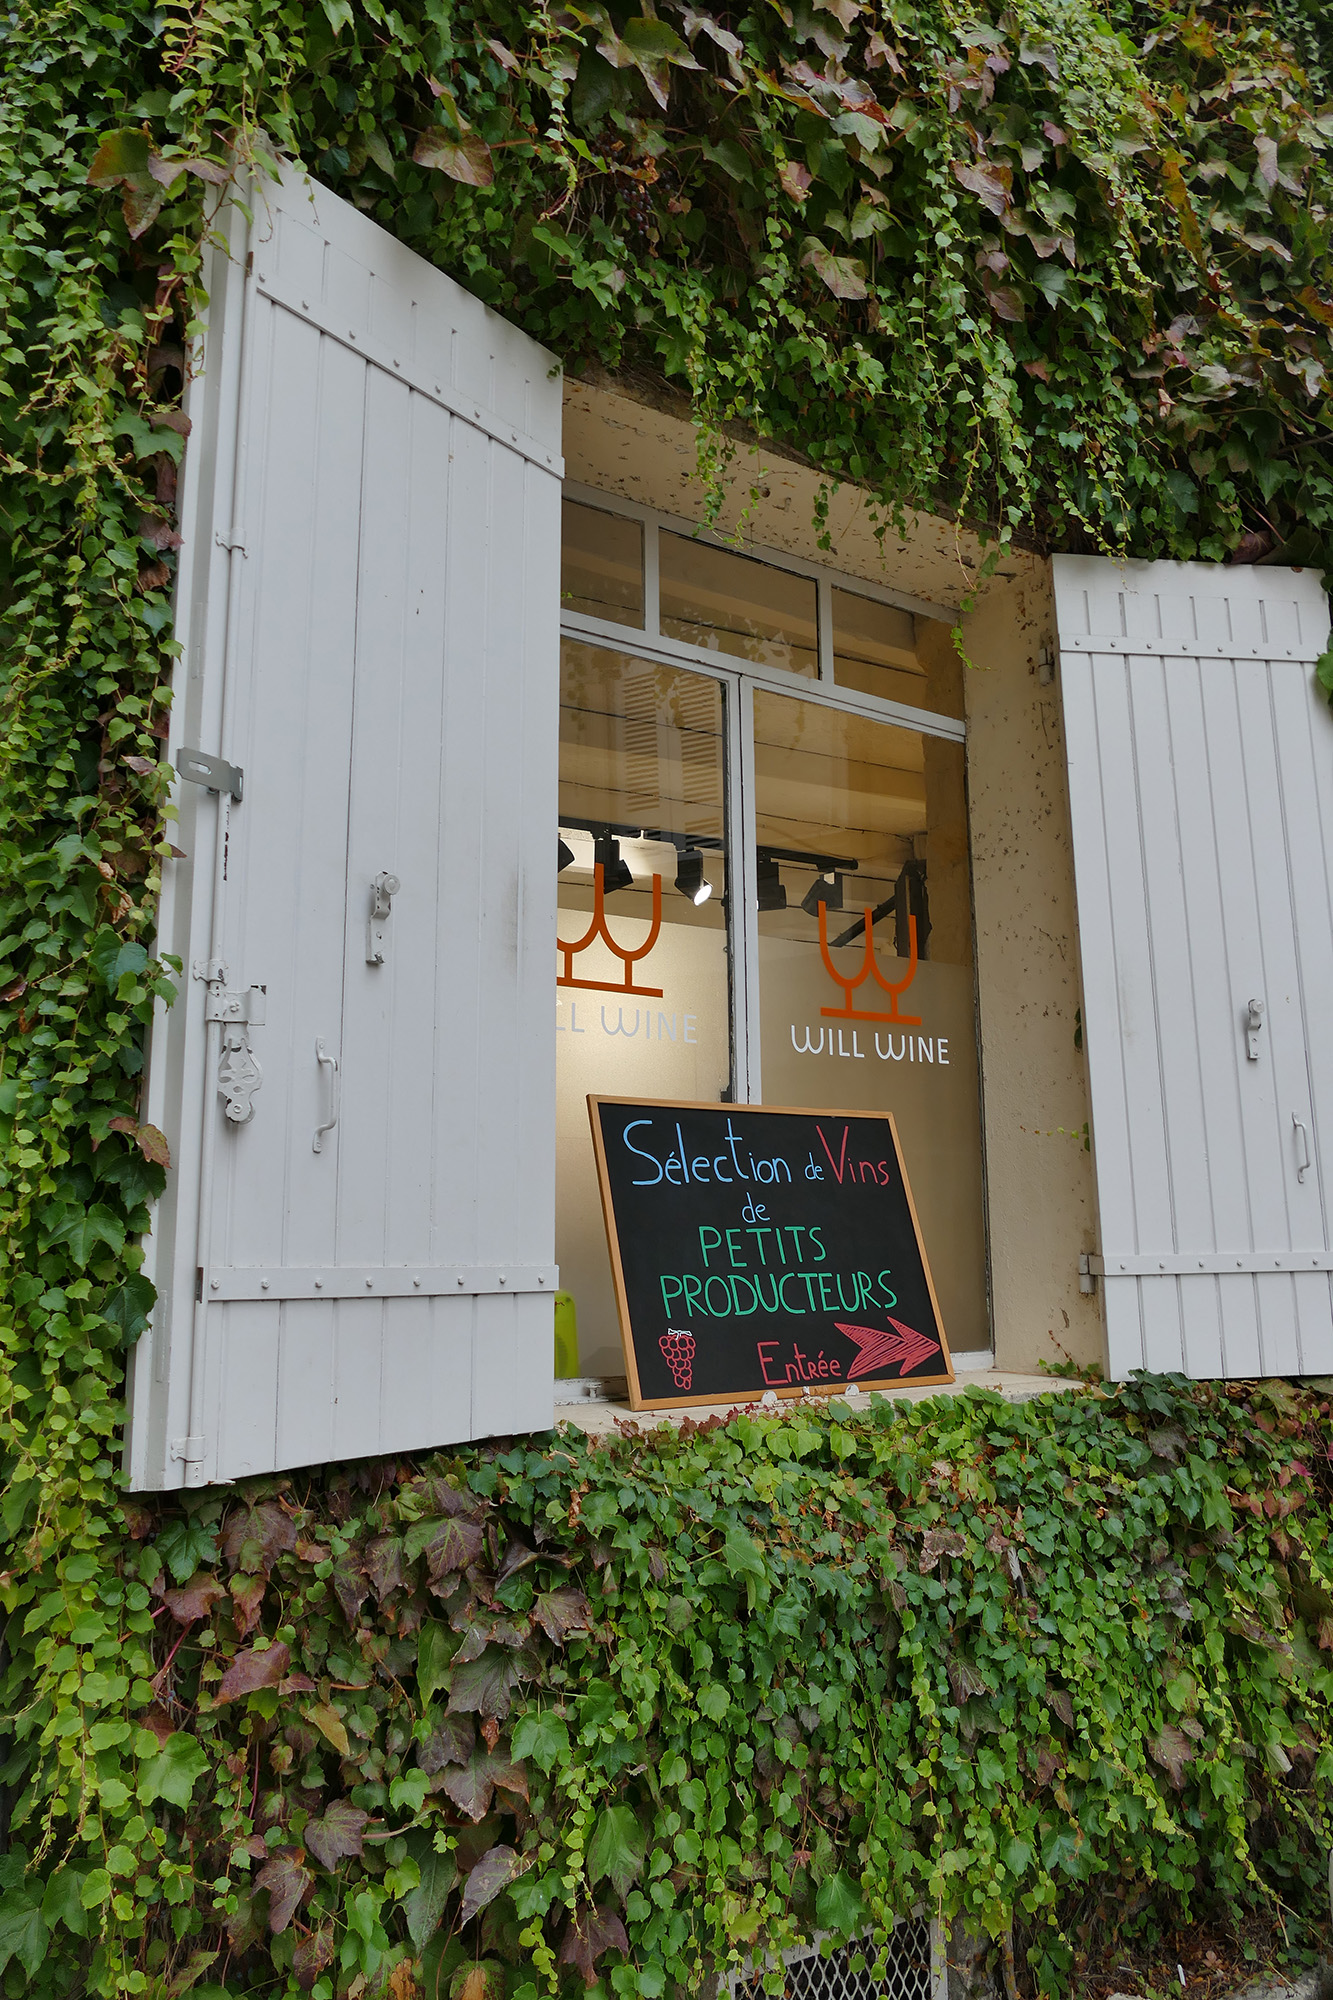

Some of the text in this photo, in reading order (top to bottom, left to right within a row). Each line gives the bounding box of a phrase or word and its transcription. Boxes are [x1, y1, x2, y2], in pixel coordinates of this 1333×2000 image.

[601, 1005, 697, 1043] WINE
[791, 1024, 950, 1065] WILL WINE
[622, 1117, 891, 1187] Sélection de Vins
[741, 1191, 771, 1224] de
[698, 1225, 828, 1268] PETITS
[660, 1270, 897, 1318] PRODUCTEURS
[757, 1341, 842, 1385] Entrée
